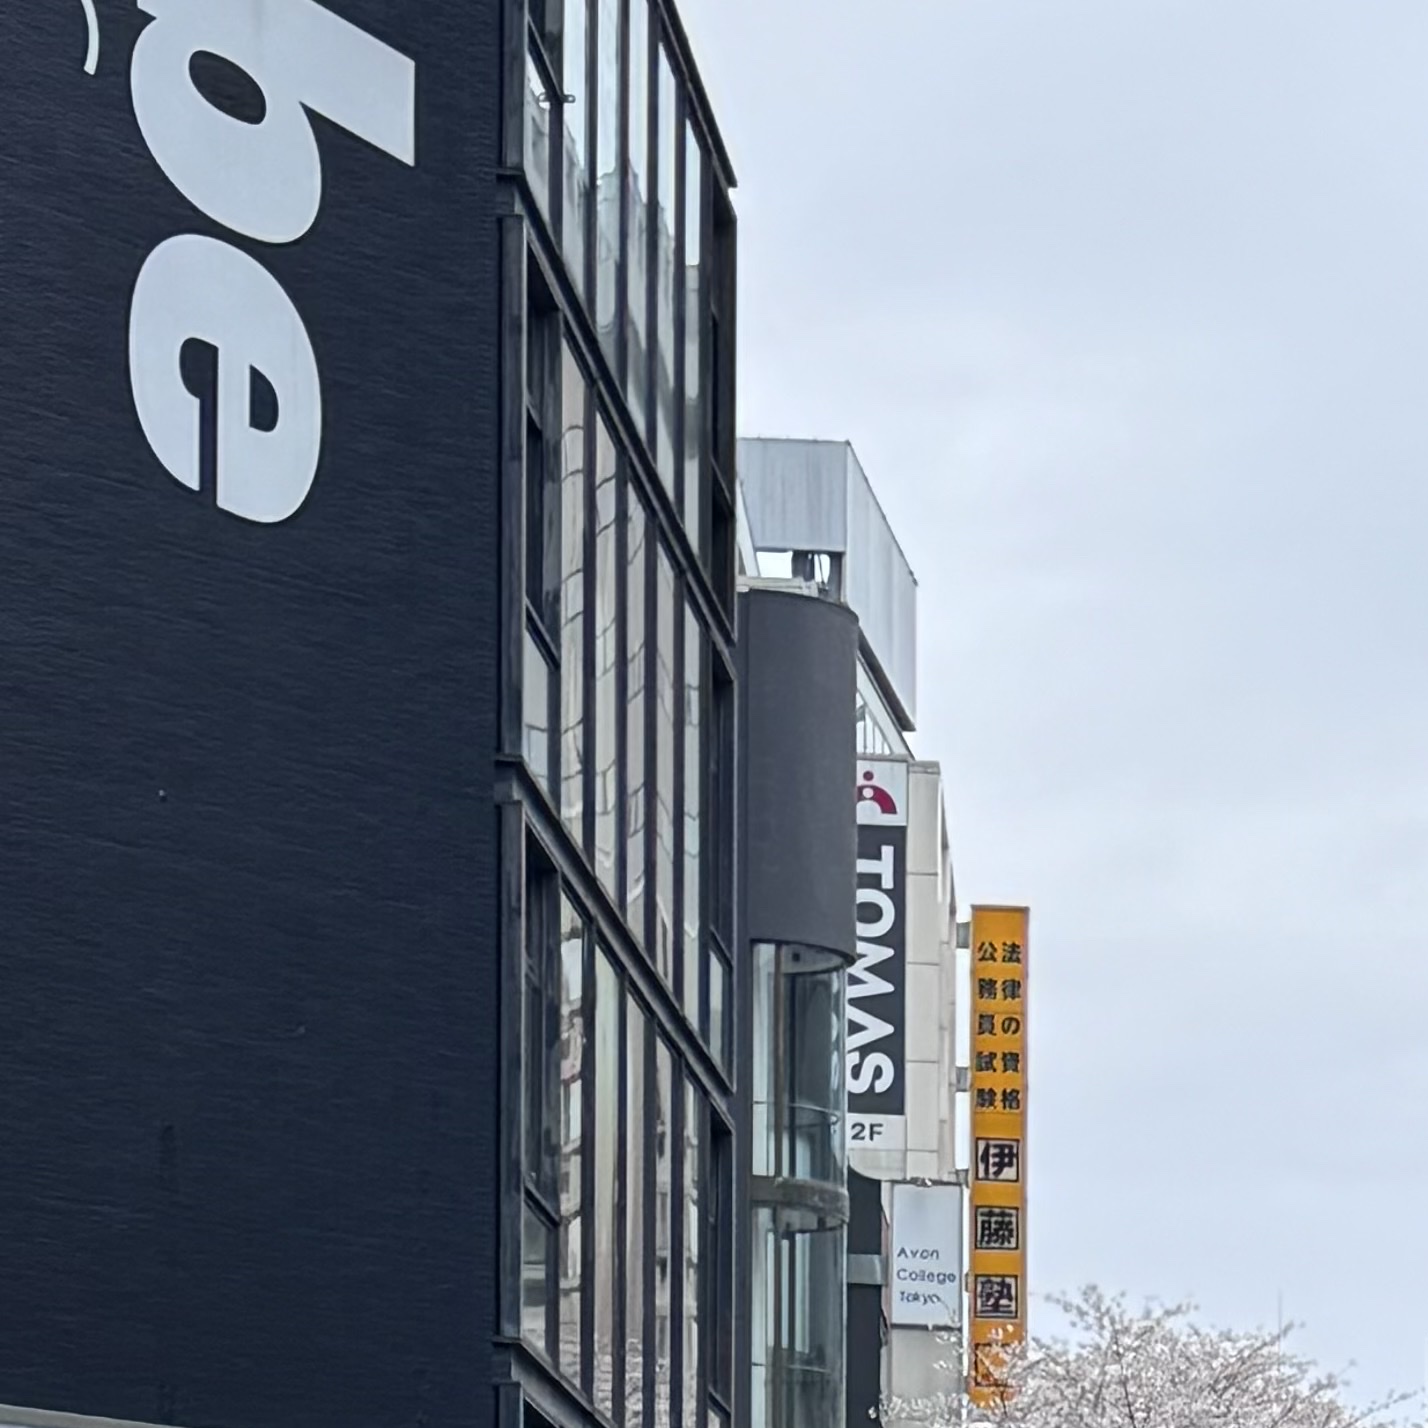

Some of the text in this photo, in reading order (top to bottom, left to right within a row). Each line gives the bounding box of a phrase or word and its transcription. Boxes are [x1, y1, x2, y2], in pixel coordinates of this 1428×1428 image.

[846, 845, 896, 1095] TOMAS
[975, 942, 998, 1110] 公務員試験
[1000, 942, 1022, 1110] 法律の資格
[851, 1122, 884, 1141] 2F
[896, 1247, 940, 1261] Avon
[979, 1141, 1018, 1316] 伊藤塾
